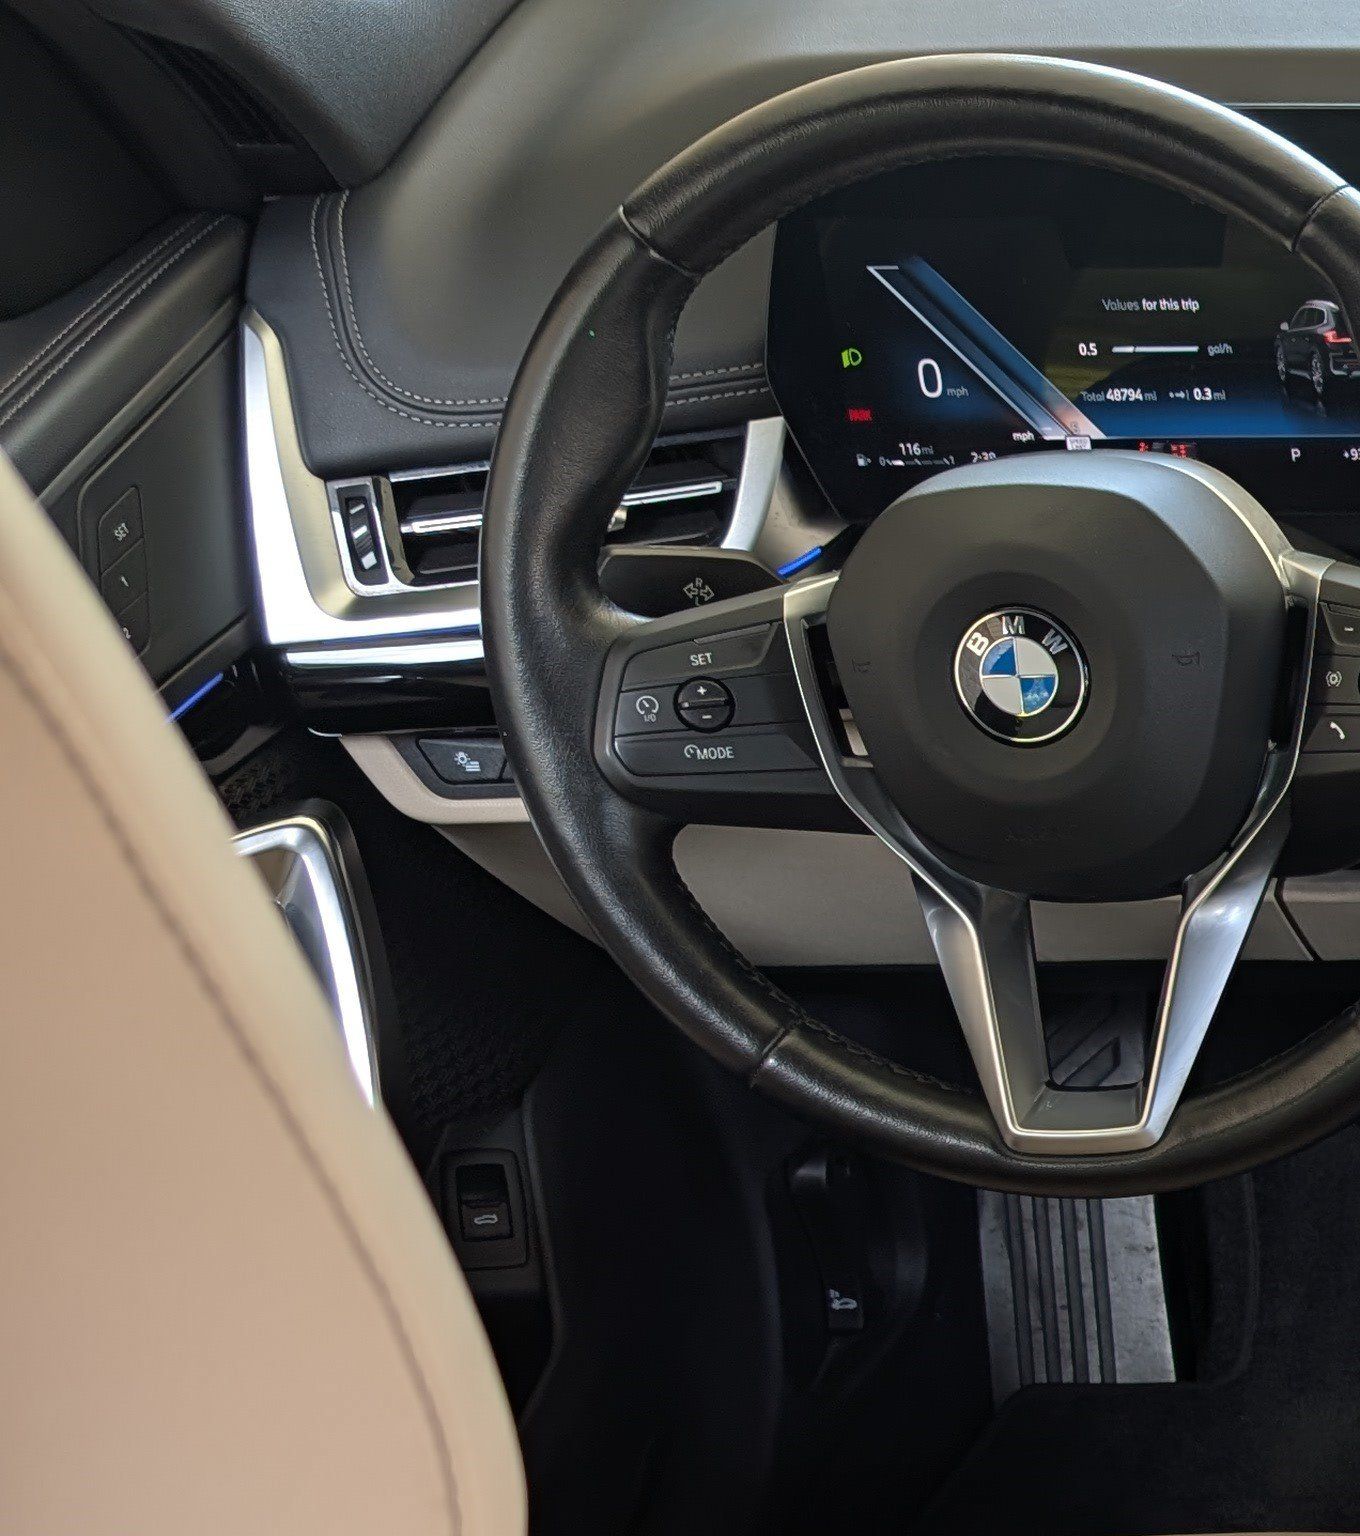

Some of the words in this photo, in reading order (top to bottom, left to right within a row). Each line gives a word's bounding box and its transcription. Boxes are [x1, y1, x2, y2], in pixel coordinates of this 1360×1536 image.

[1102, 298, 1139, 311] Values
[1142, 298, 1158, 311] for
[1159, 298, 1179, 311] this
[1181, 298, 1200, 313] trip
[1078, 342, 1098, 356] 0.5
[917, 357, 943, 399] 0
[947, 386, 969, 397] mph
[1082, 391, 1105, 402] Total
[1106, 387, 1143, 402] 48794
[1144, 391, 1157, 401] mi
[1193, 387, 1212, 401] 0.3
[1214, 390, 1226, 401] mi
[1012, 431, 1035, 443] mph
[899, 443, 922, 456] 116
[1291, 448, 1301, 462] P
[114, 522, 129, 541] SET
[966, 615, 1068, 656] BMW
[690, 652, 713, 667] SET
[697, 746, 734, 760] MODE
